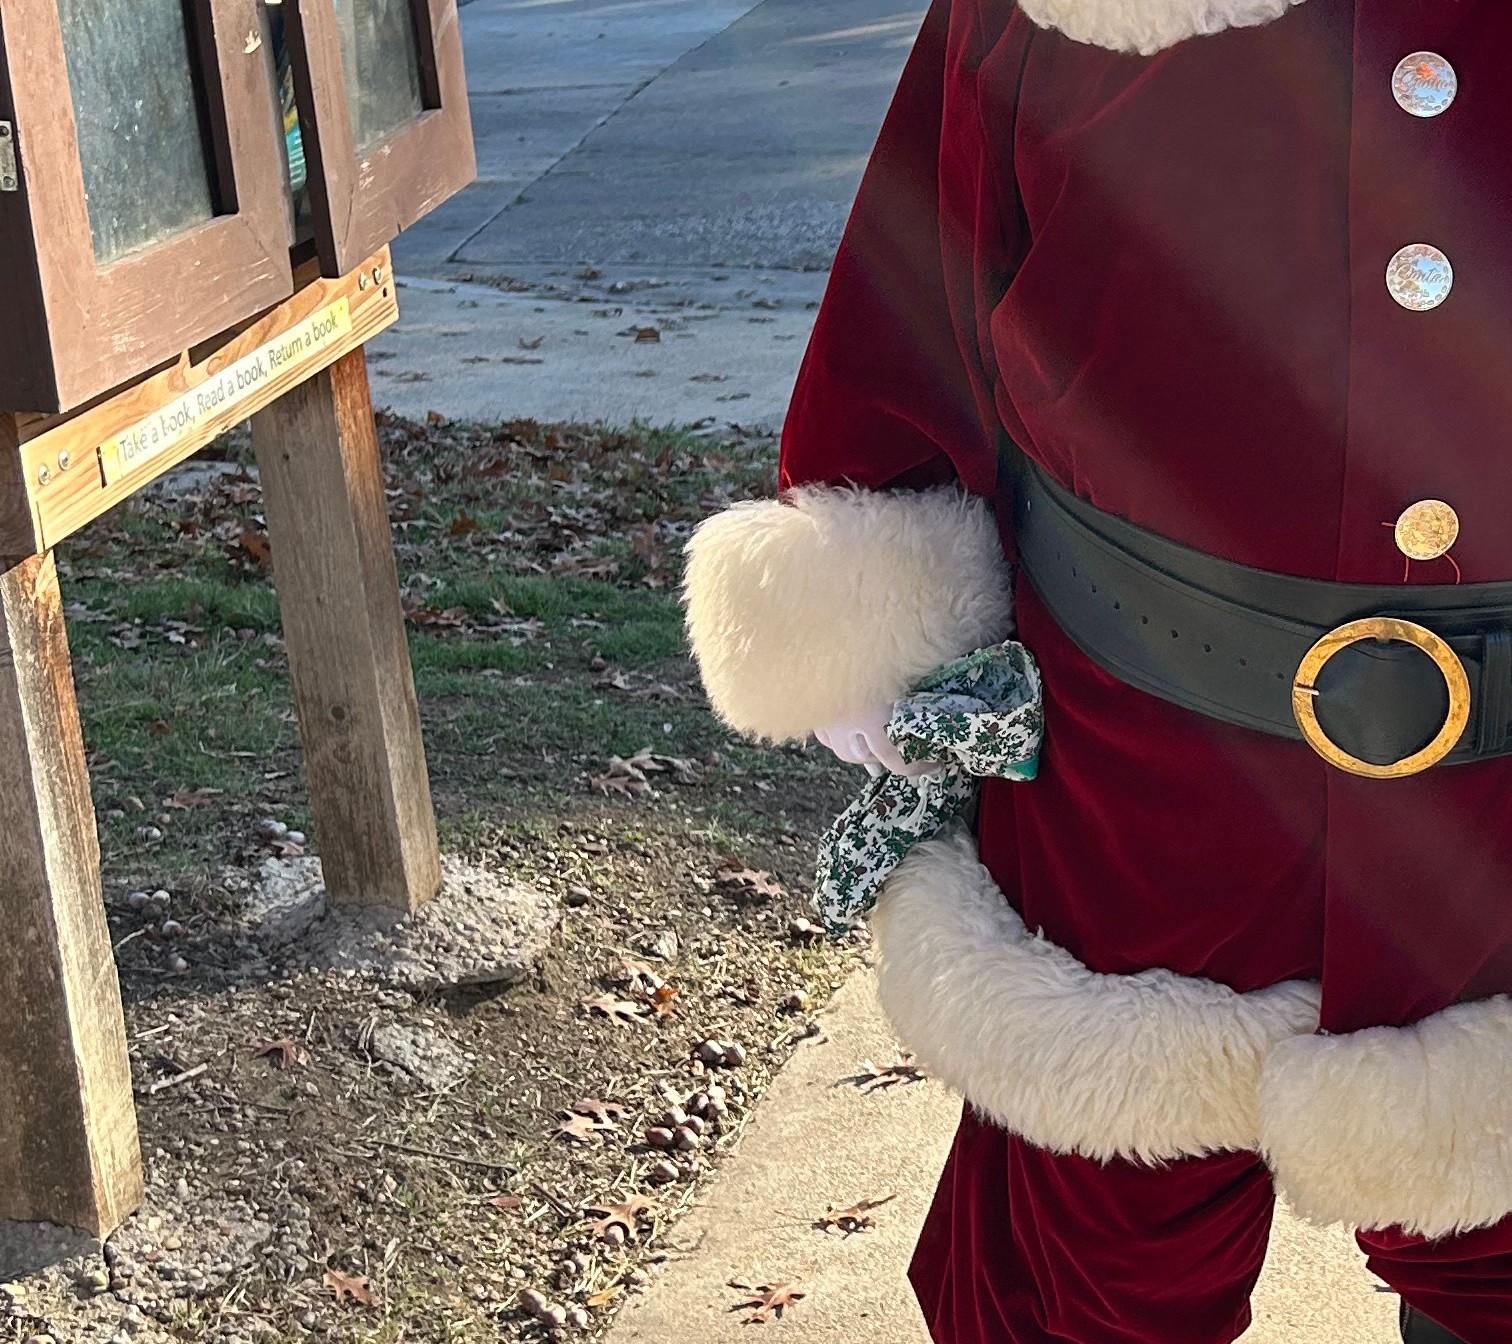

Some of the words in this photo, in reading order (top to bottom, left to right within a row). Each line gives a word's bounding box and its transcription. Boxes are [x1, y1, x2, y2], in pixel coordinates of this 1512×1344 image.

[119, 429, 149, 462] Take
[151, 429, 159, 444] a
[161, 401, 196, 437] book,
[197, 380, 225, 415] Read
[227, 380, 235, 396] a
[237, 358, 268, 390] book,
[268, 337, 303, 369] Return
[305, 332, 312, 347] a
[312, 309, 338, 340] book
